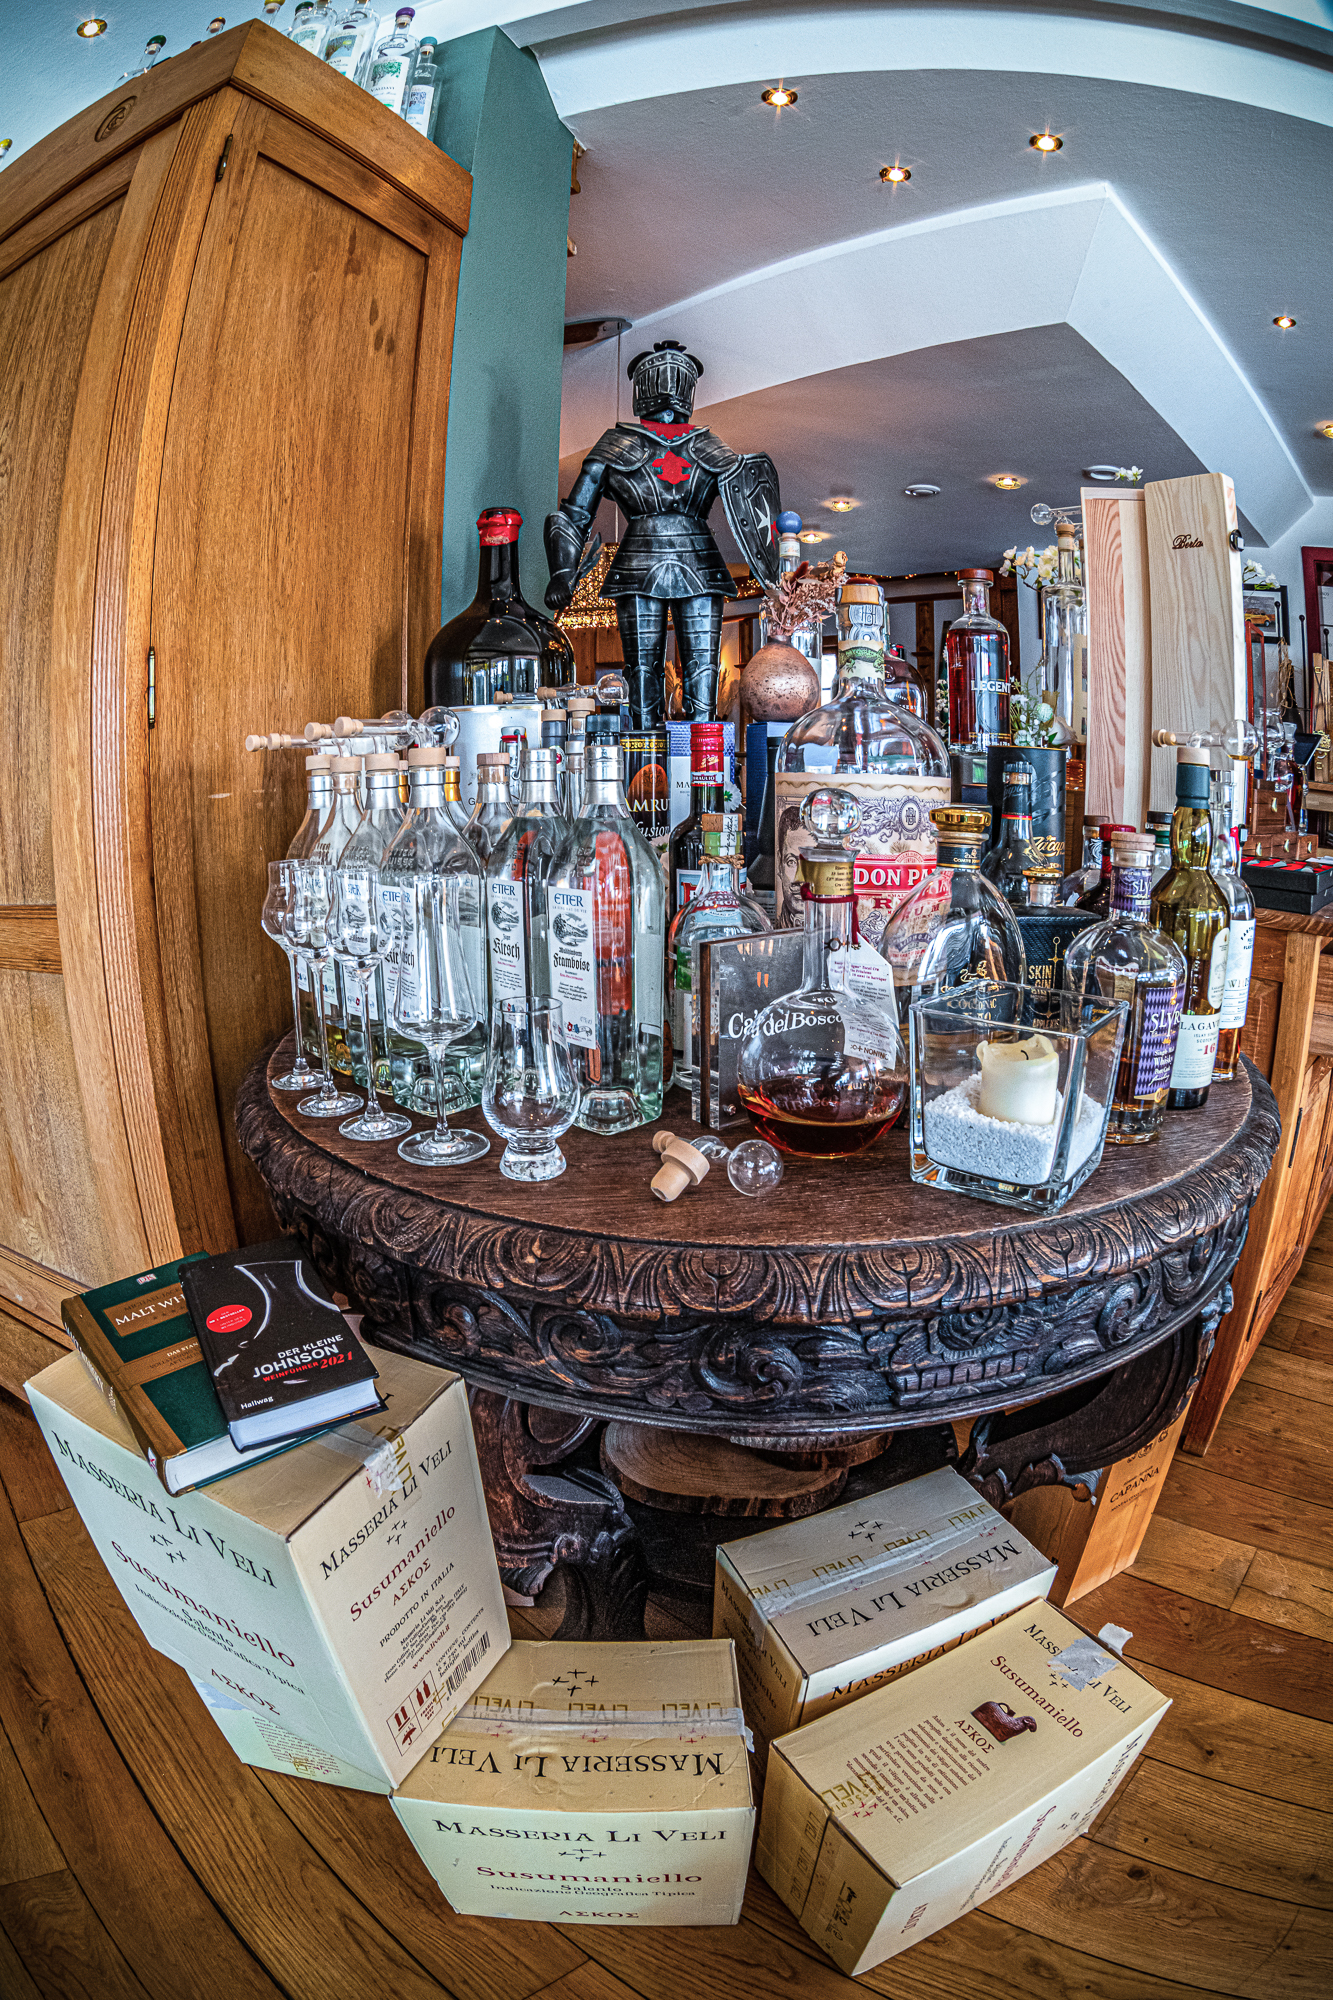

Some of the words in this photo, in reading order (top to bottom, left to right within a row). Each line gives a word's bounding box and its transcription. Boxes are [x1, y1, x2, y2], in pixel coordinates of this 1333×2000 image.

[1172, 534, 1203, 550] Berta
[971, 680, 1011, 693] LEGENT
[492, 883, 516, 896] ETTER
[854, 868, 902, 887] DON
[554, 893, 584, 907] ETTER
[553, 953, 591, 972] Framboise
[1028, 965, 1052, 979] SKIN
[792, 1011, 842, 1030] Bosco
[1203, 1043, 1216, 1055] 16
[115, 1304, 157, 1326] MALT
[278, 1347, 300, 1359] DER
[303, 1335, 344, 1351] KLEINE
[253, 1344, 339, 1378] JOHNSON
[262, 1361, 319, 1382] WEINFÜHRER
[320, 1351, 353, 1369] 2021
[241, 1396, 274, 1409] Hallwag
[1110, 1467, 1159, 1503] CAPANNA
[51, 1430, 166, 1524] MASSERIA
[166, 1506, 203, 1546] LI
[202, 1528, 278, 1589] VELI
[319, 1497, 398, 1580] MASSERIA
[402, 1475, 418, 1501] LI
[419, 1440, 453, 1477] VELI
[349, 1505, 455, 1622] Susumaniello
[904, 1538, 1022, 1597] MASSERIA
[111, 1539, 295, 1668] Susumaniello
[380, 1602, 419, 1648] PRODOTTO
[420, 1590, 430, 1602] IN
[430, 1563, 455, 1592] ITALIA
[871, 1590, 906, 1611] LI
[182, 1607, 235, 1648] Salento
[806, 1607, 874, 1637] VELI
[262, 1666, 306, 1695] Tipica
[990, 1655, 1084, 1738] Susumaniello
[1102, 1685, 1133, 1714] VELI
[430, 1745, 502, 1774] VELI
[513, 1754, 548, 1778] LI
[561, 1752, 725, 1777] MASSERIA
[432, 1819, 594, 1843] MASSERIA
[607, 1829, 641, 1844] LI
[652, 1829, 727, 1843] VELI
[476, 1866, 703, 1884] Susumaniello
[490, 1884, 571, 1895] Indicazione
[560, 1884, 622, 1892] Salento
